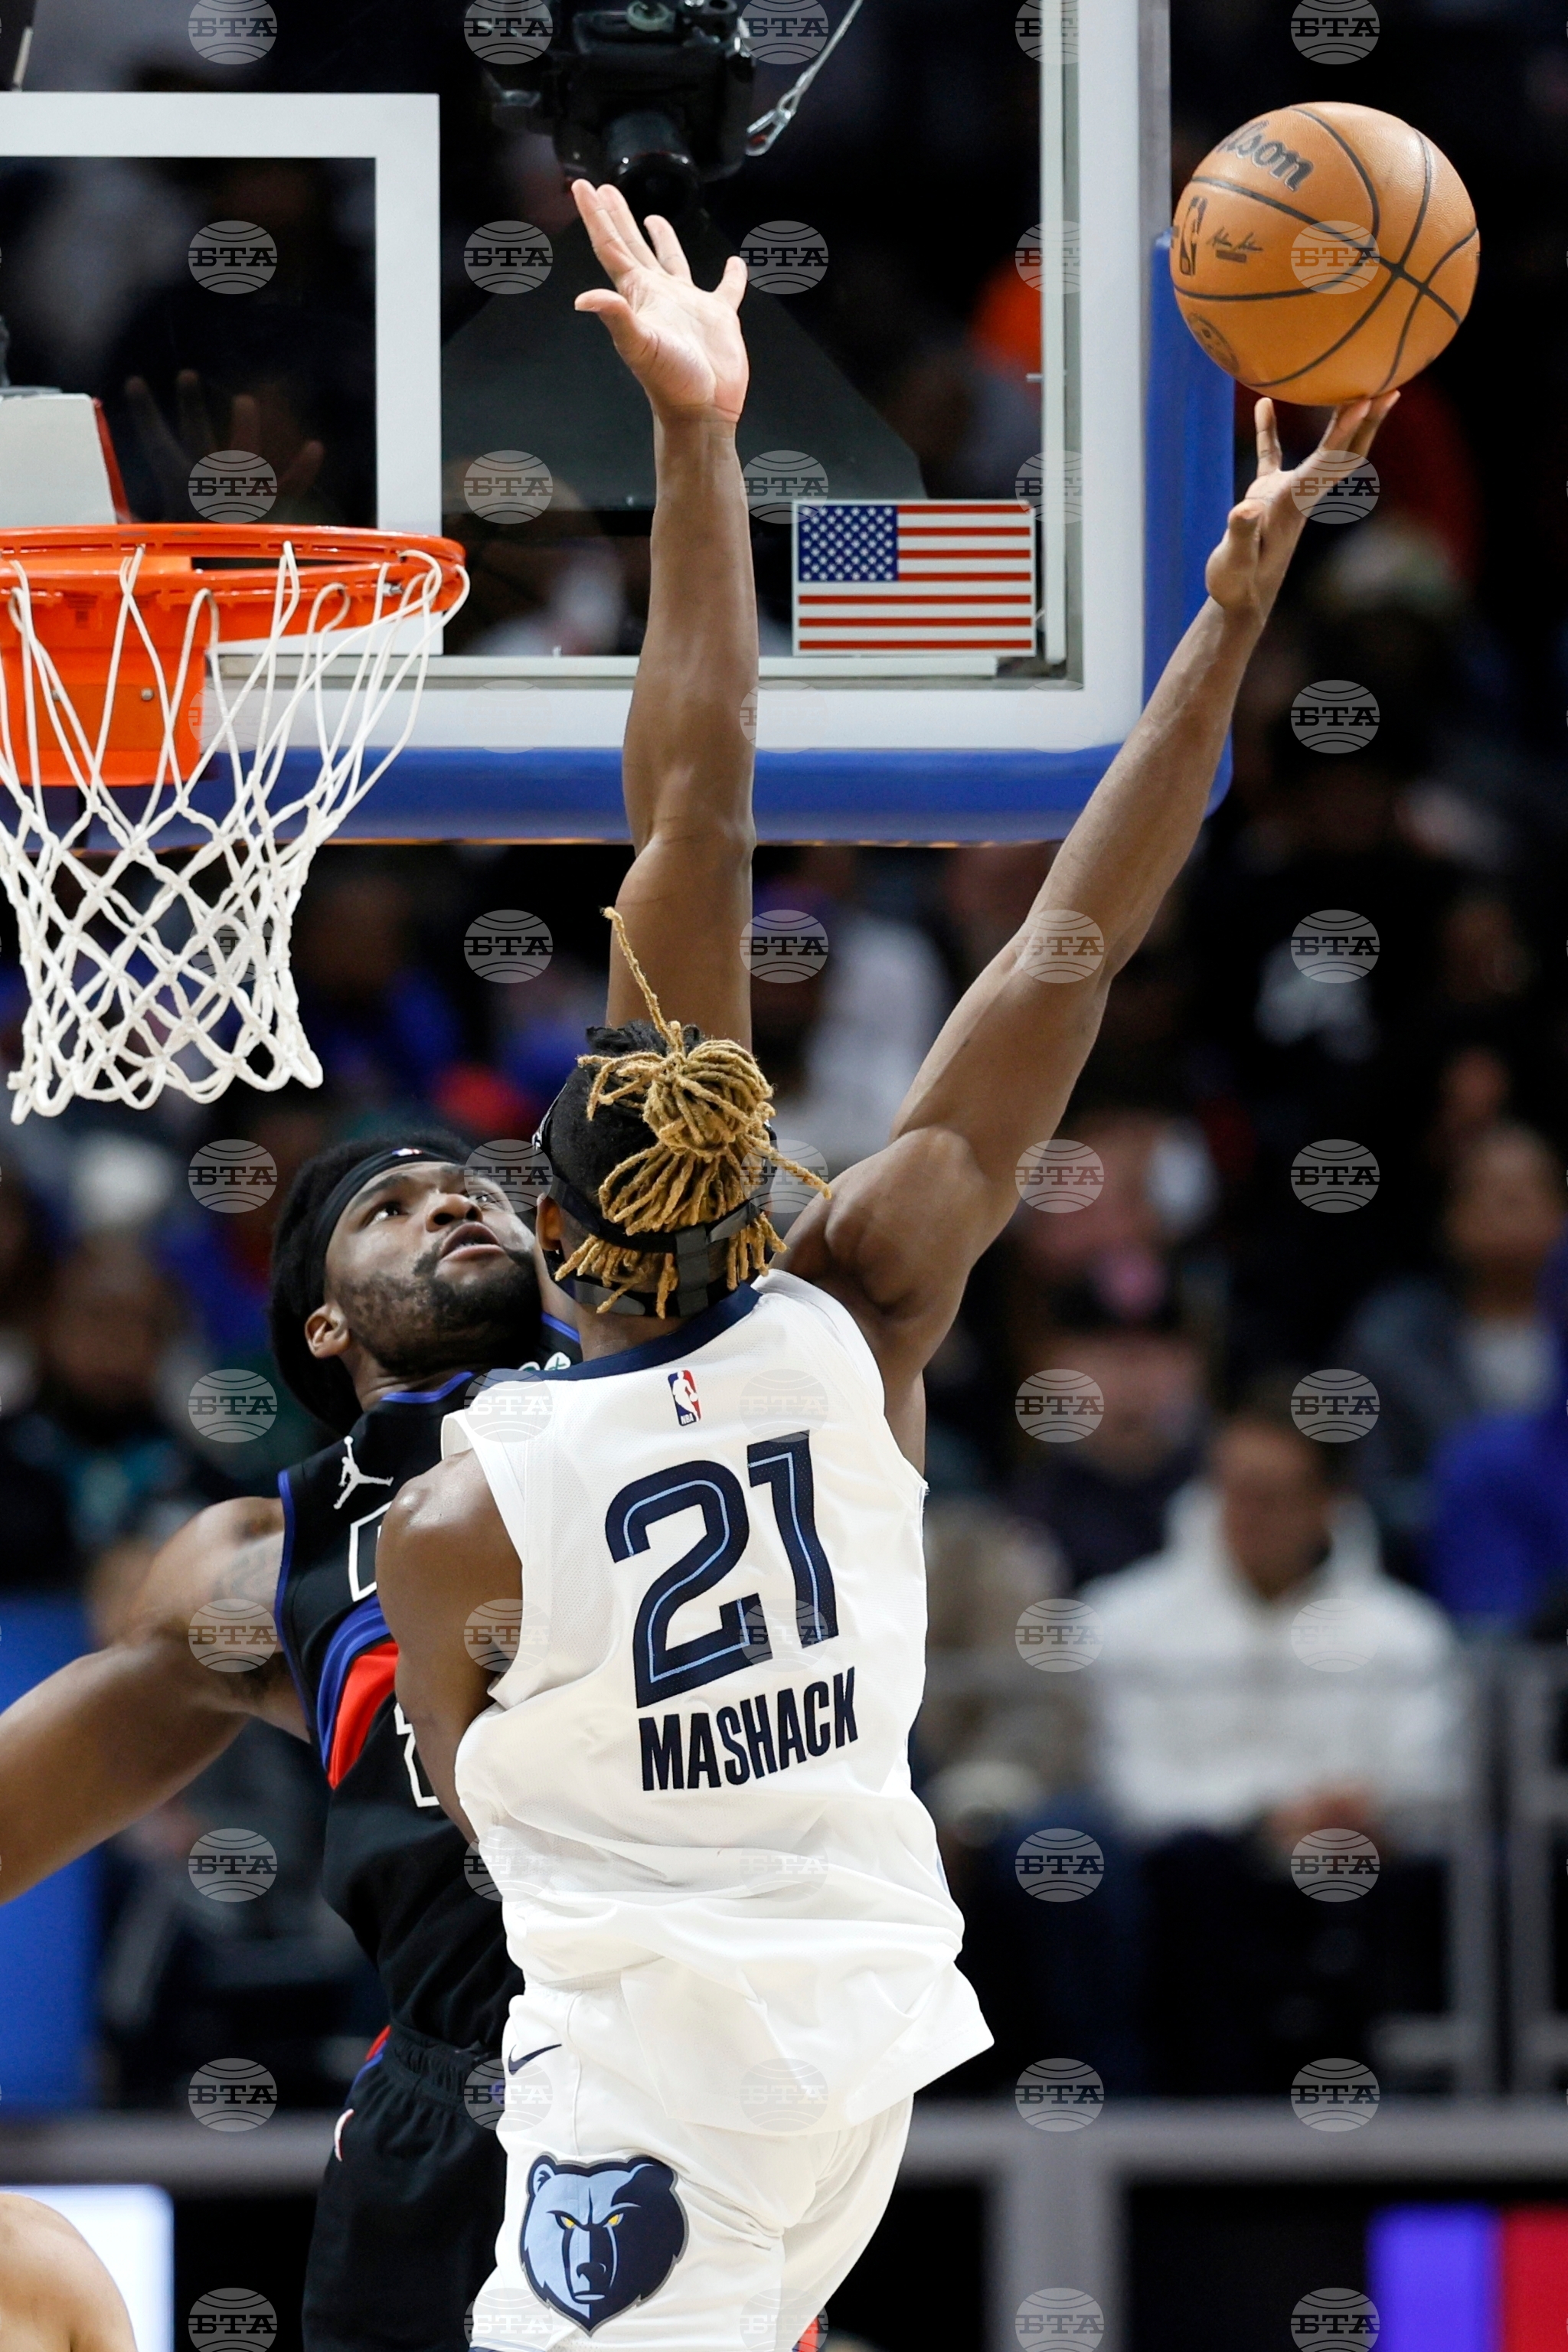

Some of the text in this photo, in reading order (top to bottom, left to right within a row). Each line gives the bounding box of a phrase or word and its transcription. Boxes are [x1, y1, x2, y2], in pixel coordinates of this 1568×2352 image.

[681, 1413, 694, 1425] NBA
[605, 1430, 839, 1708] 21
[639, 1666, 858, 1792] MASHACK
